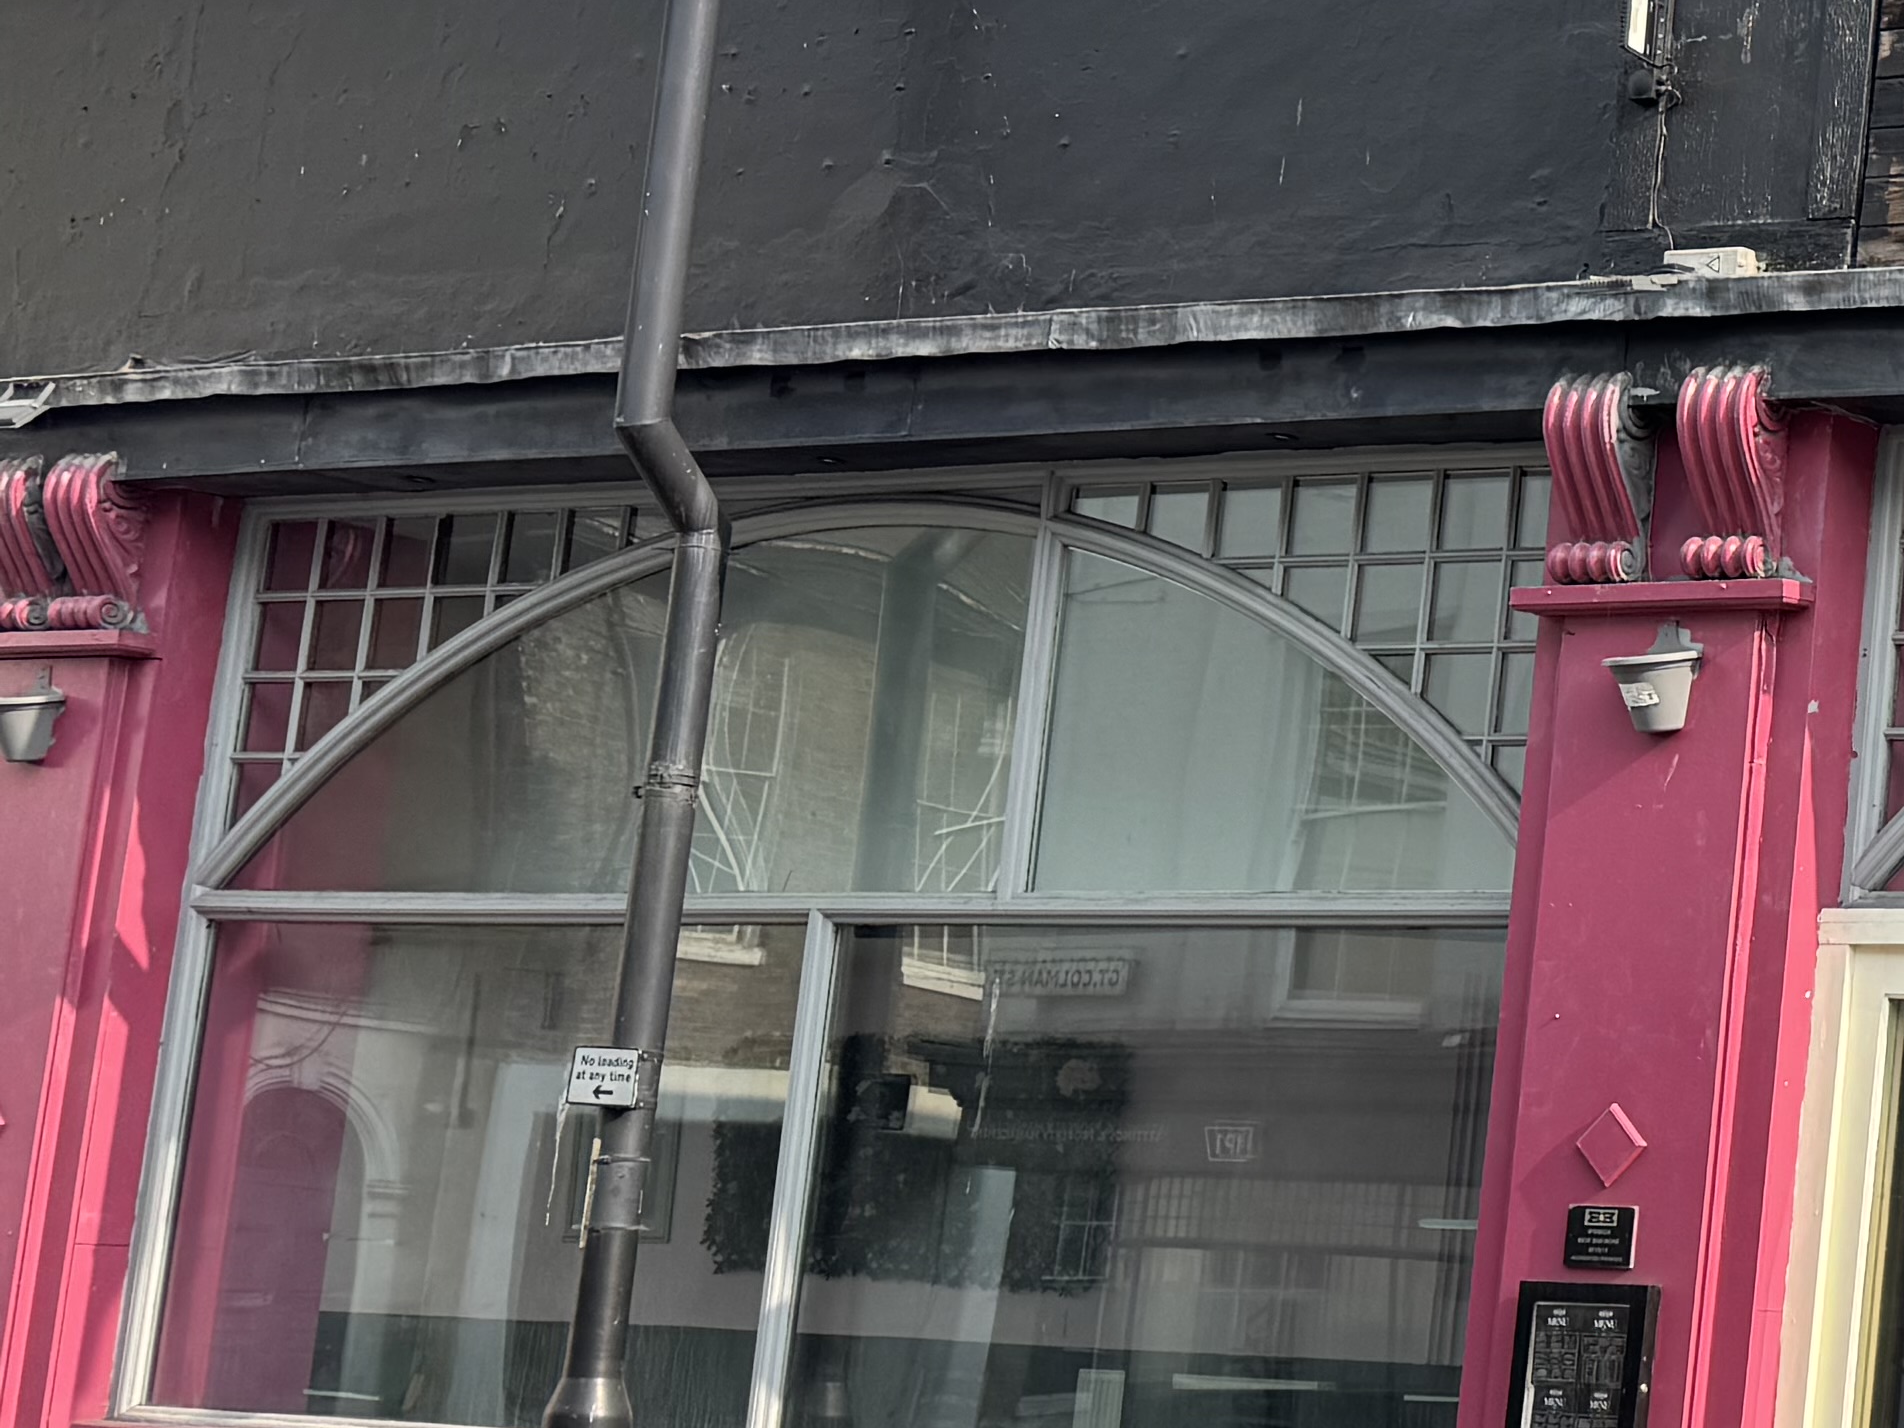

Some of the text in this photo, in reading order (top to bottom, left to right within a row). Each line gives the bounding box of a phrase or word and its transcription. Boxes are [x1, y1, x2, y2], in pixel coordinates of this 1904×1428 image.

[580, 1054, 634, 1070] No loading
[576, 1070, 631, 1083] at any time
